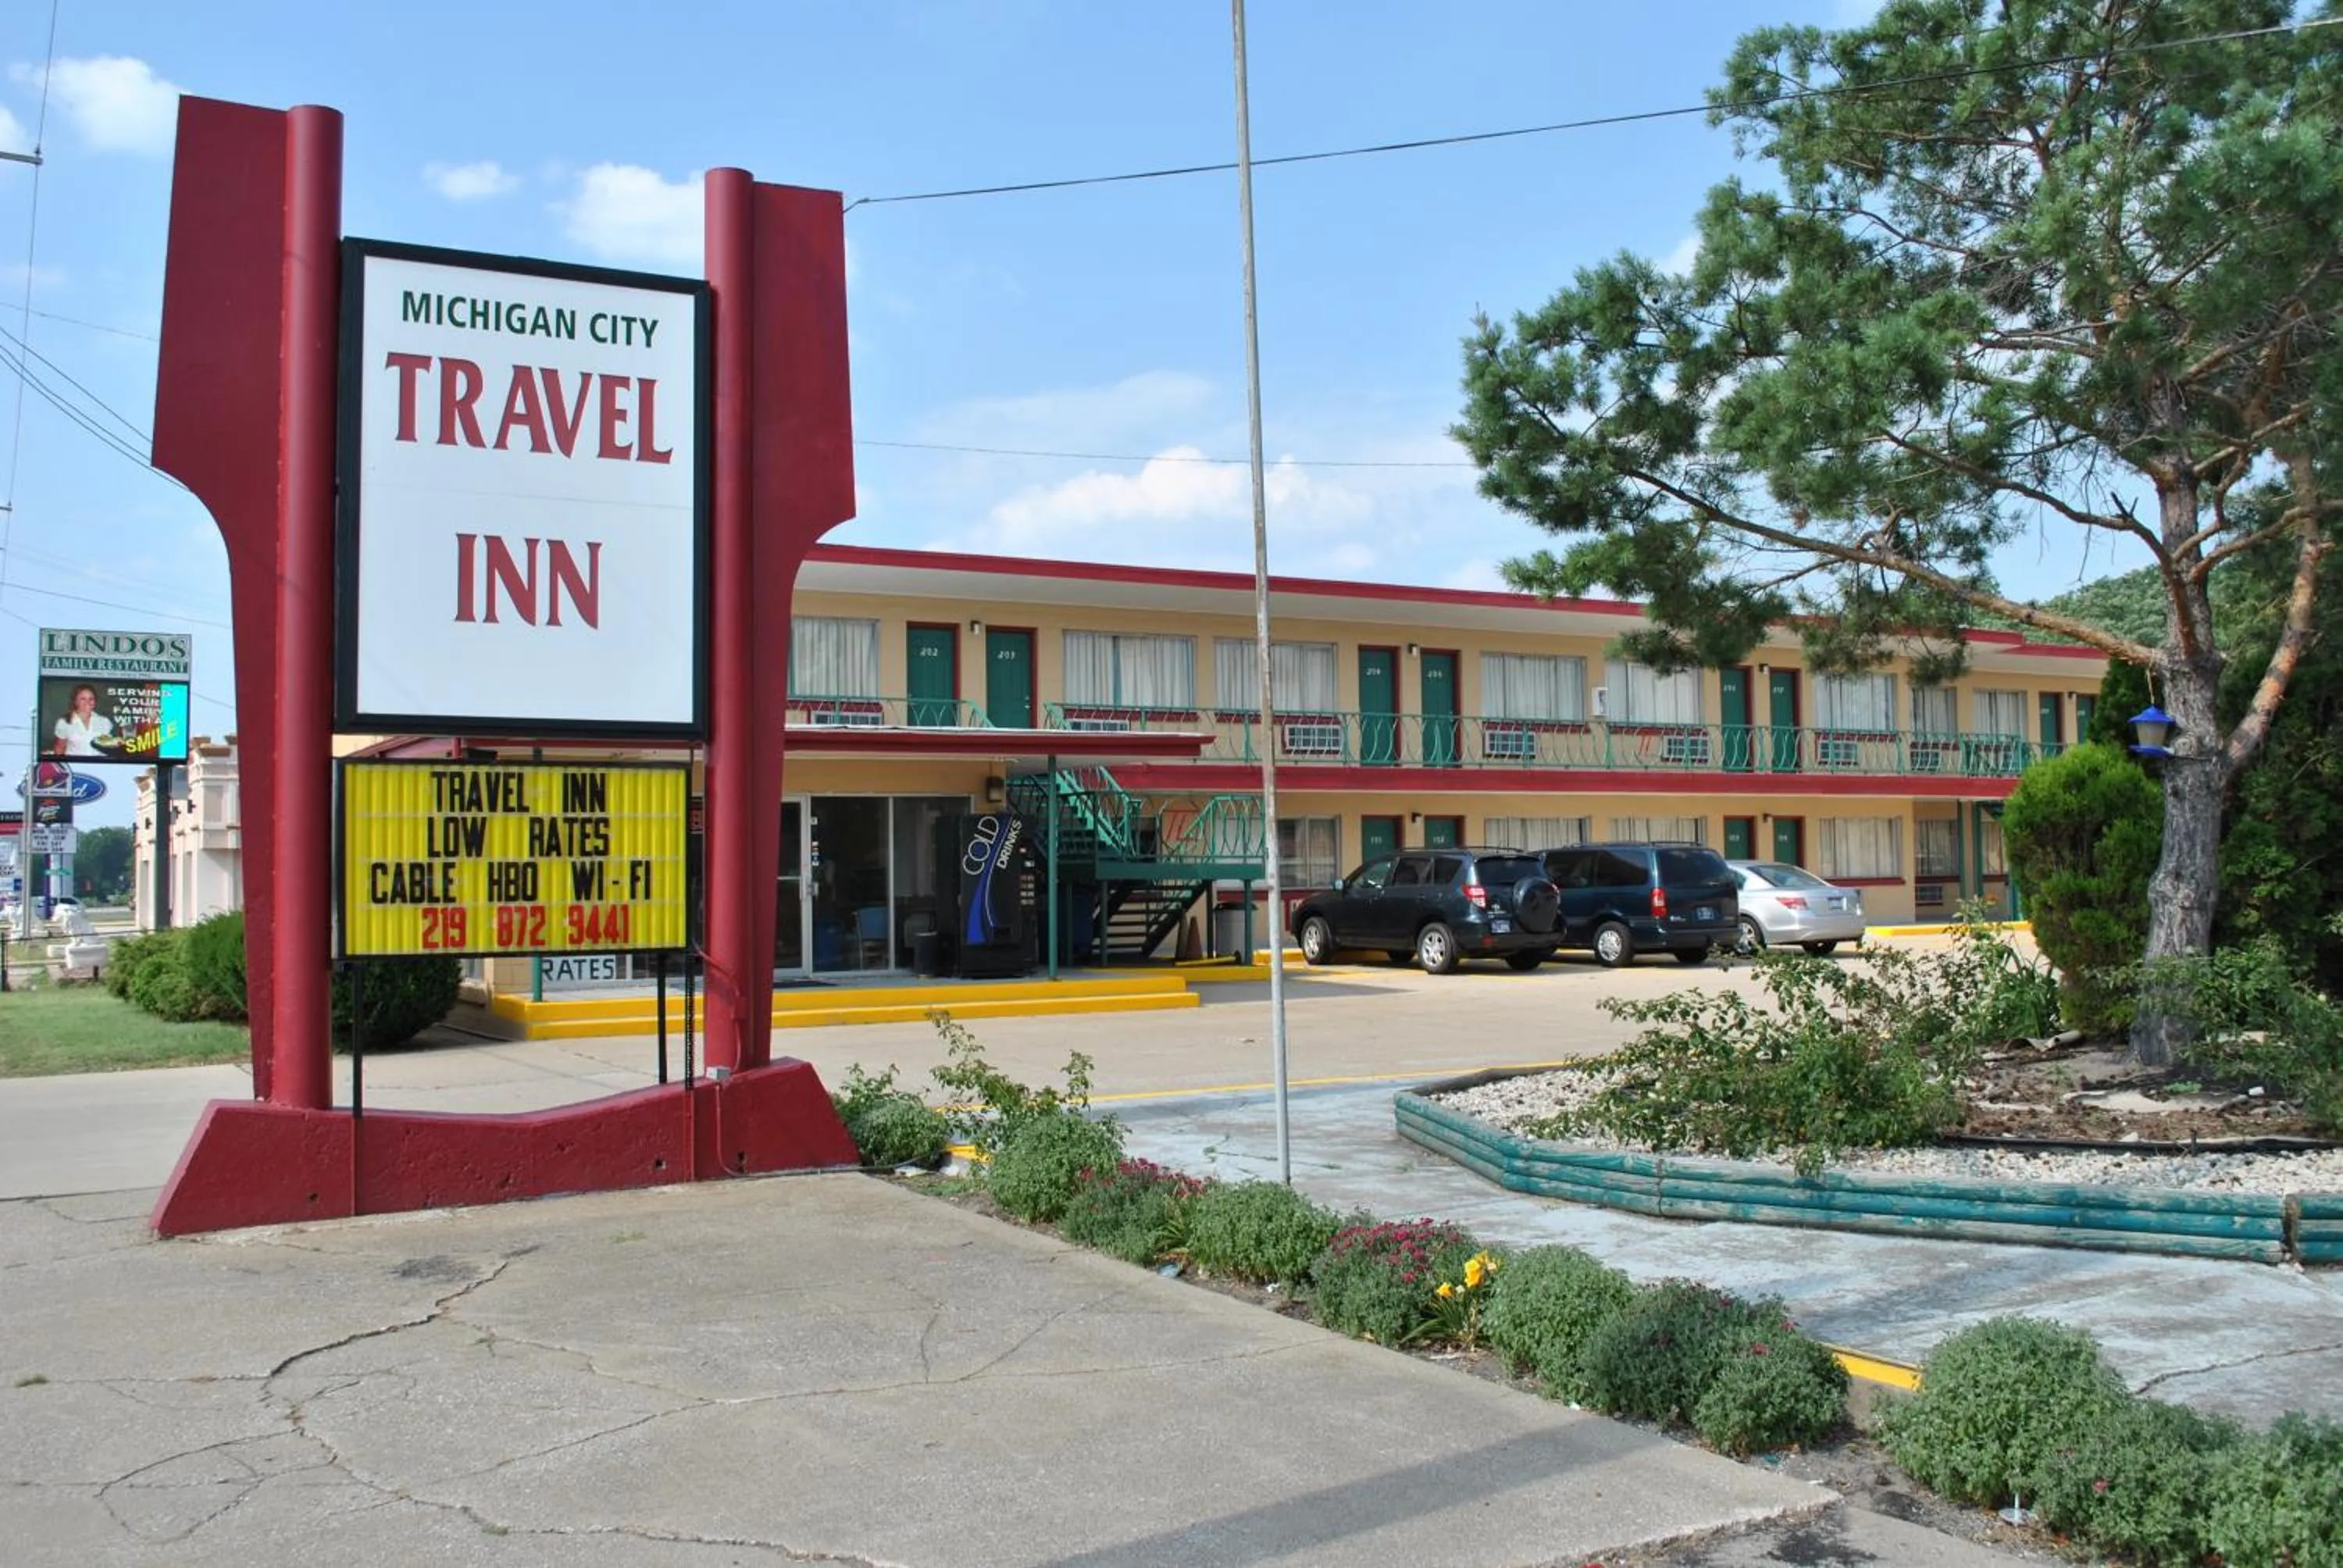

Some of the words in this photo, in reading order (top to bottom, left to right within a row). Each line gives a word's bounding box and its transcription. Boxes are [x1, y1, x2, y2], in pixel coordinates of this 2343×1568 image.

[401, 290, 576, 340] MICHIGAN
[589, 312, 660, 349] CITY
[385, 351, 674, 465] TRAVEL
[455, 533, 603, 631] INN
[44, 657, 98, 670] FAMILY
[98, 658, 188, 673] RESTAURANT
[47, 633, 187, 658] LINDOS
[107, 688, 173, 697] SERVING
[113, 715, 151, 725] WITH
[125, 721, 177, 754] SMILE
[430, 771, 530, 813] TRAVEL
[562, 772, 606, 813] INN
[426, 816, 487, 858] LOW
[529, 816, 611, 857] RATES
[962, 816, 999, 875] COLD
[997, 819, 1022, 869] DRINKS
[371, 861, 457, 904] CABLE
[487, 861, 539, 903] HBO
[422, 907, 467, 950] 219
[497, 905, 547, 947] 872
[567, 903, 630, 945] 9441
[541, 958, 615, 981] RATES
